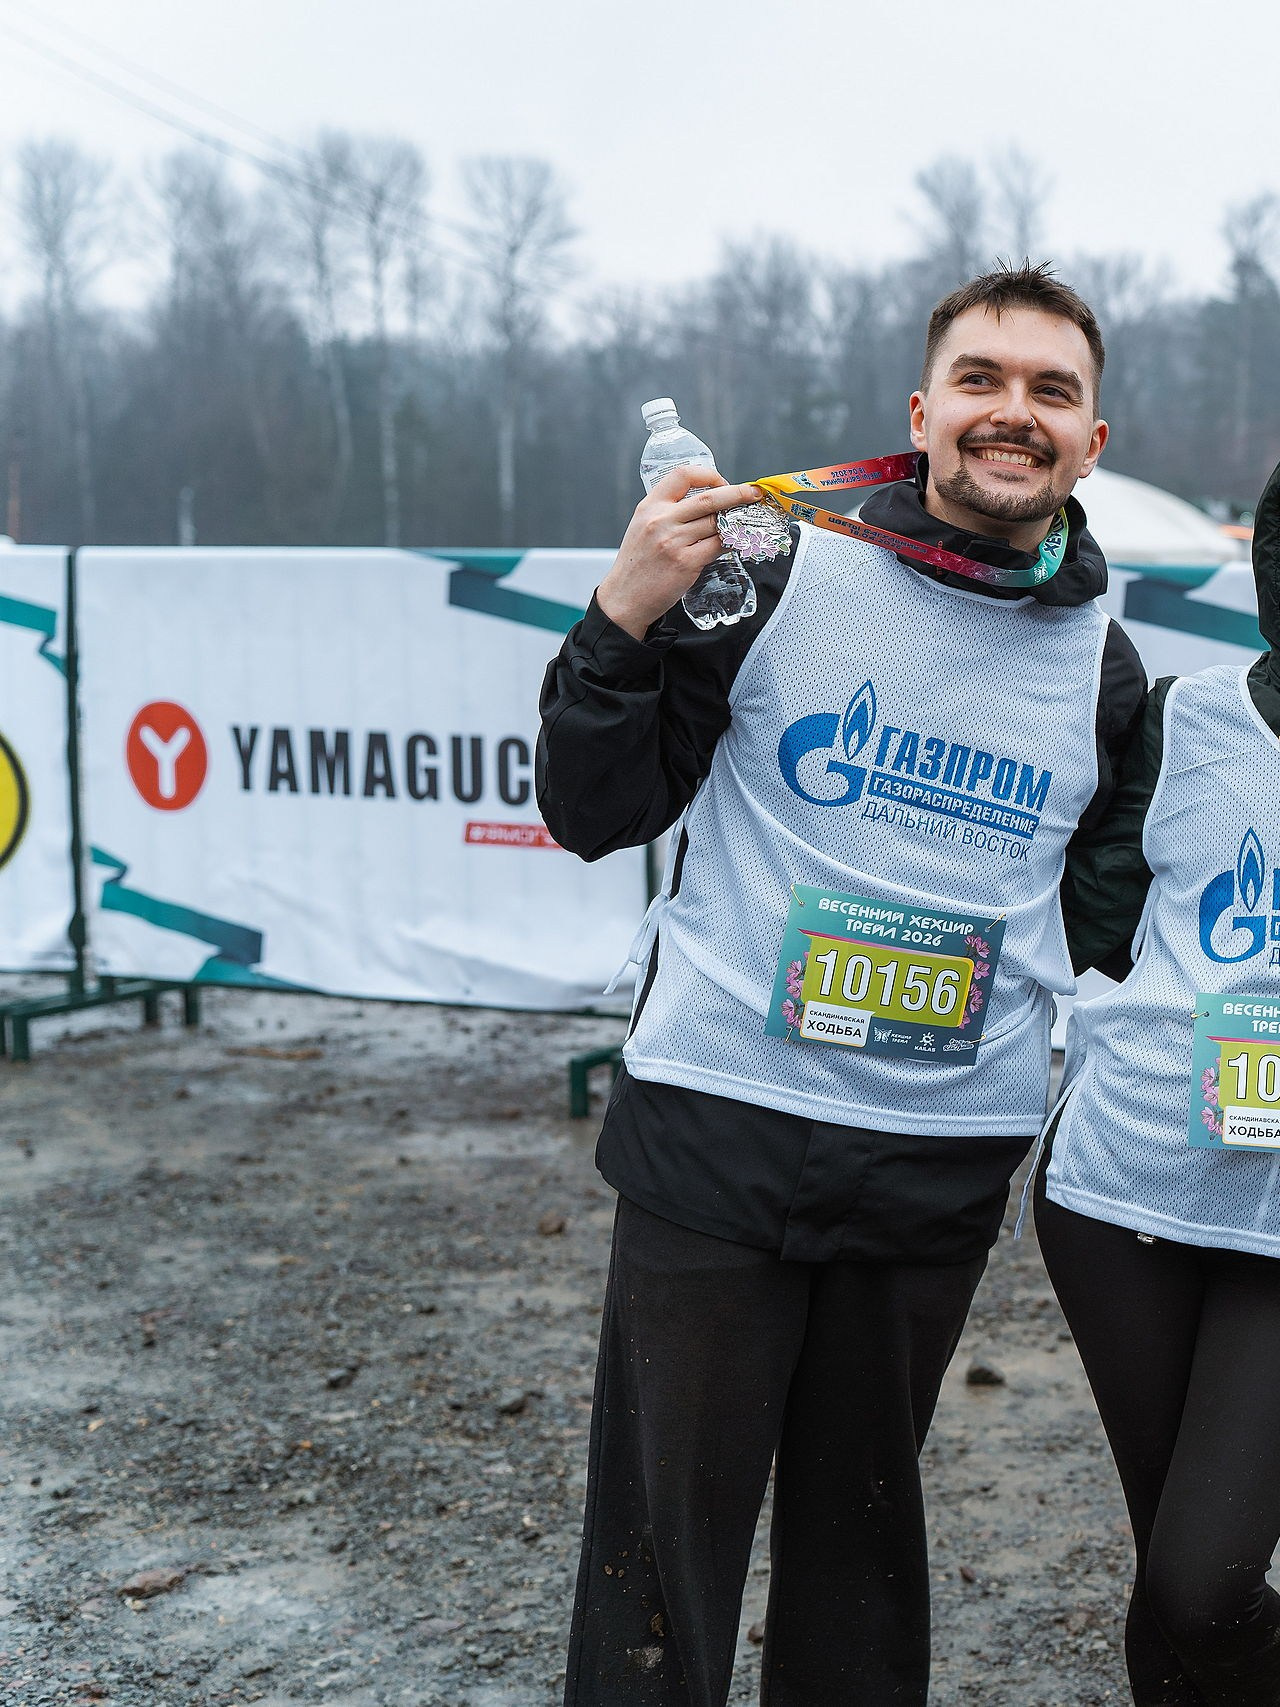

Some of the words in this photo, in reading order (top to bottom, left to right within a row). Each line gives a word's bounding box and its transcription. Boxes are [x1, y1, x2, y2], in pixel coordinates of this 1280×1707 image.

[828, 517, 861, 531] ЦВЕТЫ
[874, 725, 1053, 812] ГАЗПРОМ
[873, 777, 1037, 835] ГАЗОРАСПРЕДЕЛЕНИЕ
[861, 801, 957, 843] ДАЛЬНИЙ
[961, 828, 1031, 862] ВОСТОК
[818, 898, 905, 925] ВЕСЕННИЙ
[909, 915, 974, 936] ХЕХЦИР
[845, 919, 897, 939] ТРЕЙЛ
[901, 929, 944, 947] 2026
[815, 949, 961, 1015] 10156
[806, 1019, 862, 1038] ХОДЬБА
[809, 1010, 865, 1024] СКАНДИНАВСКАЯ
